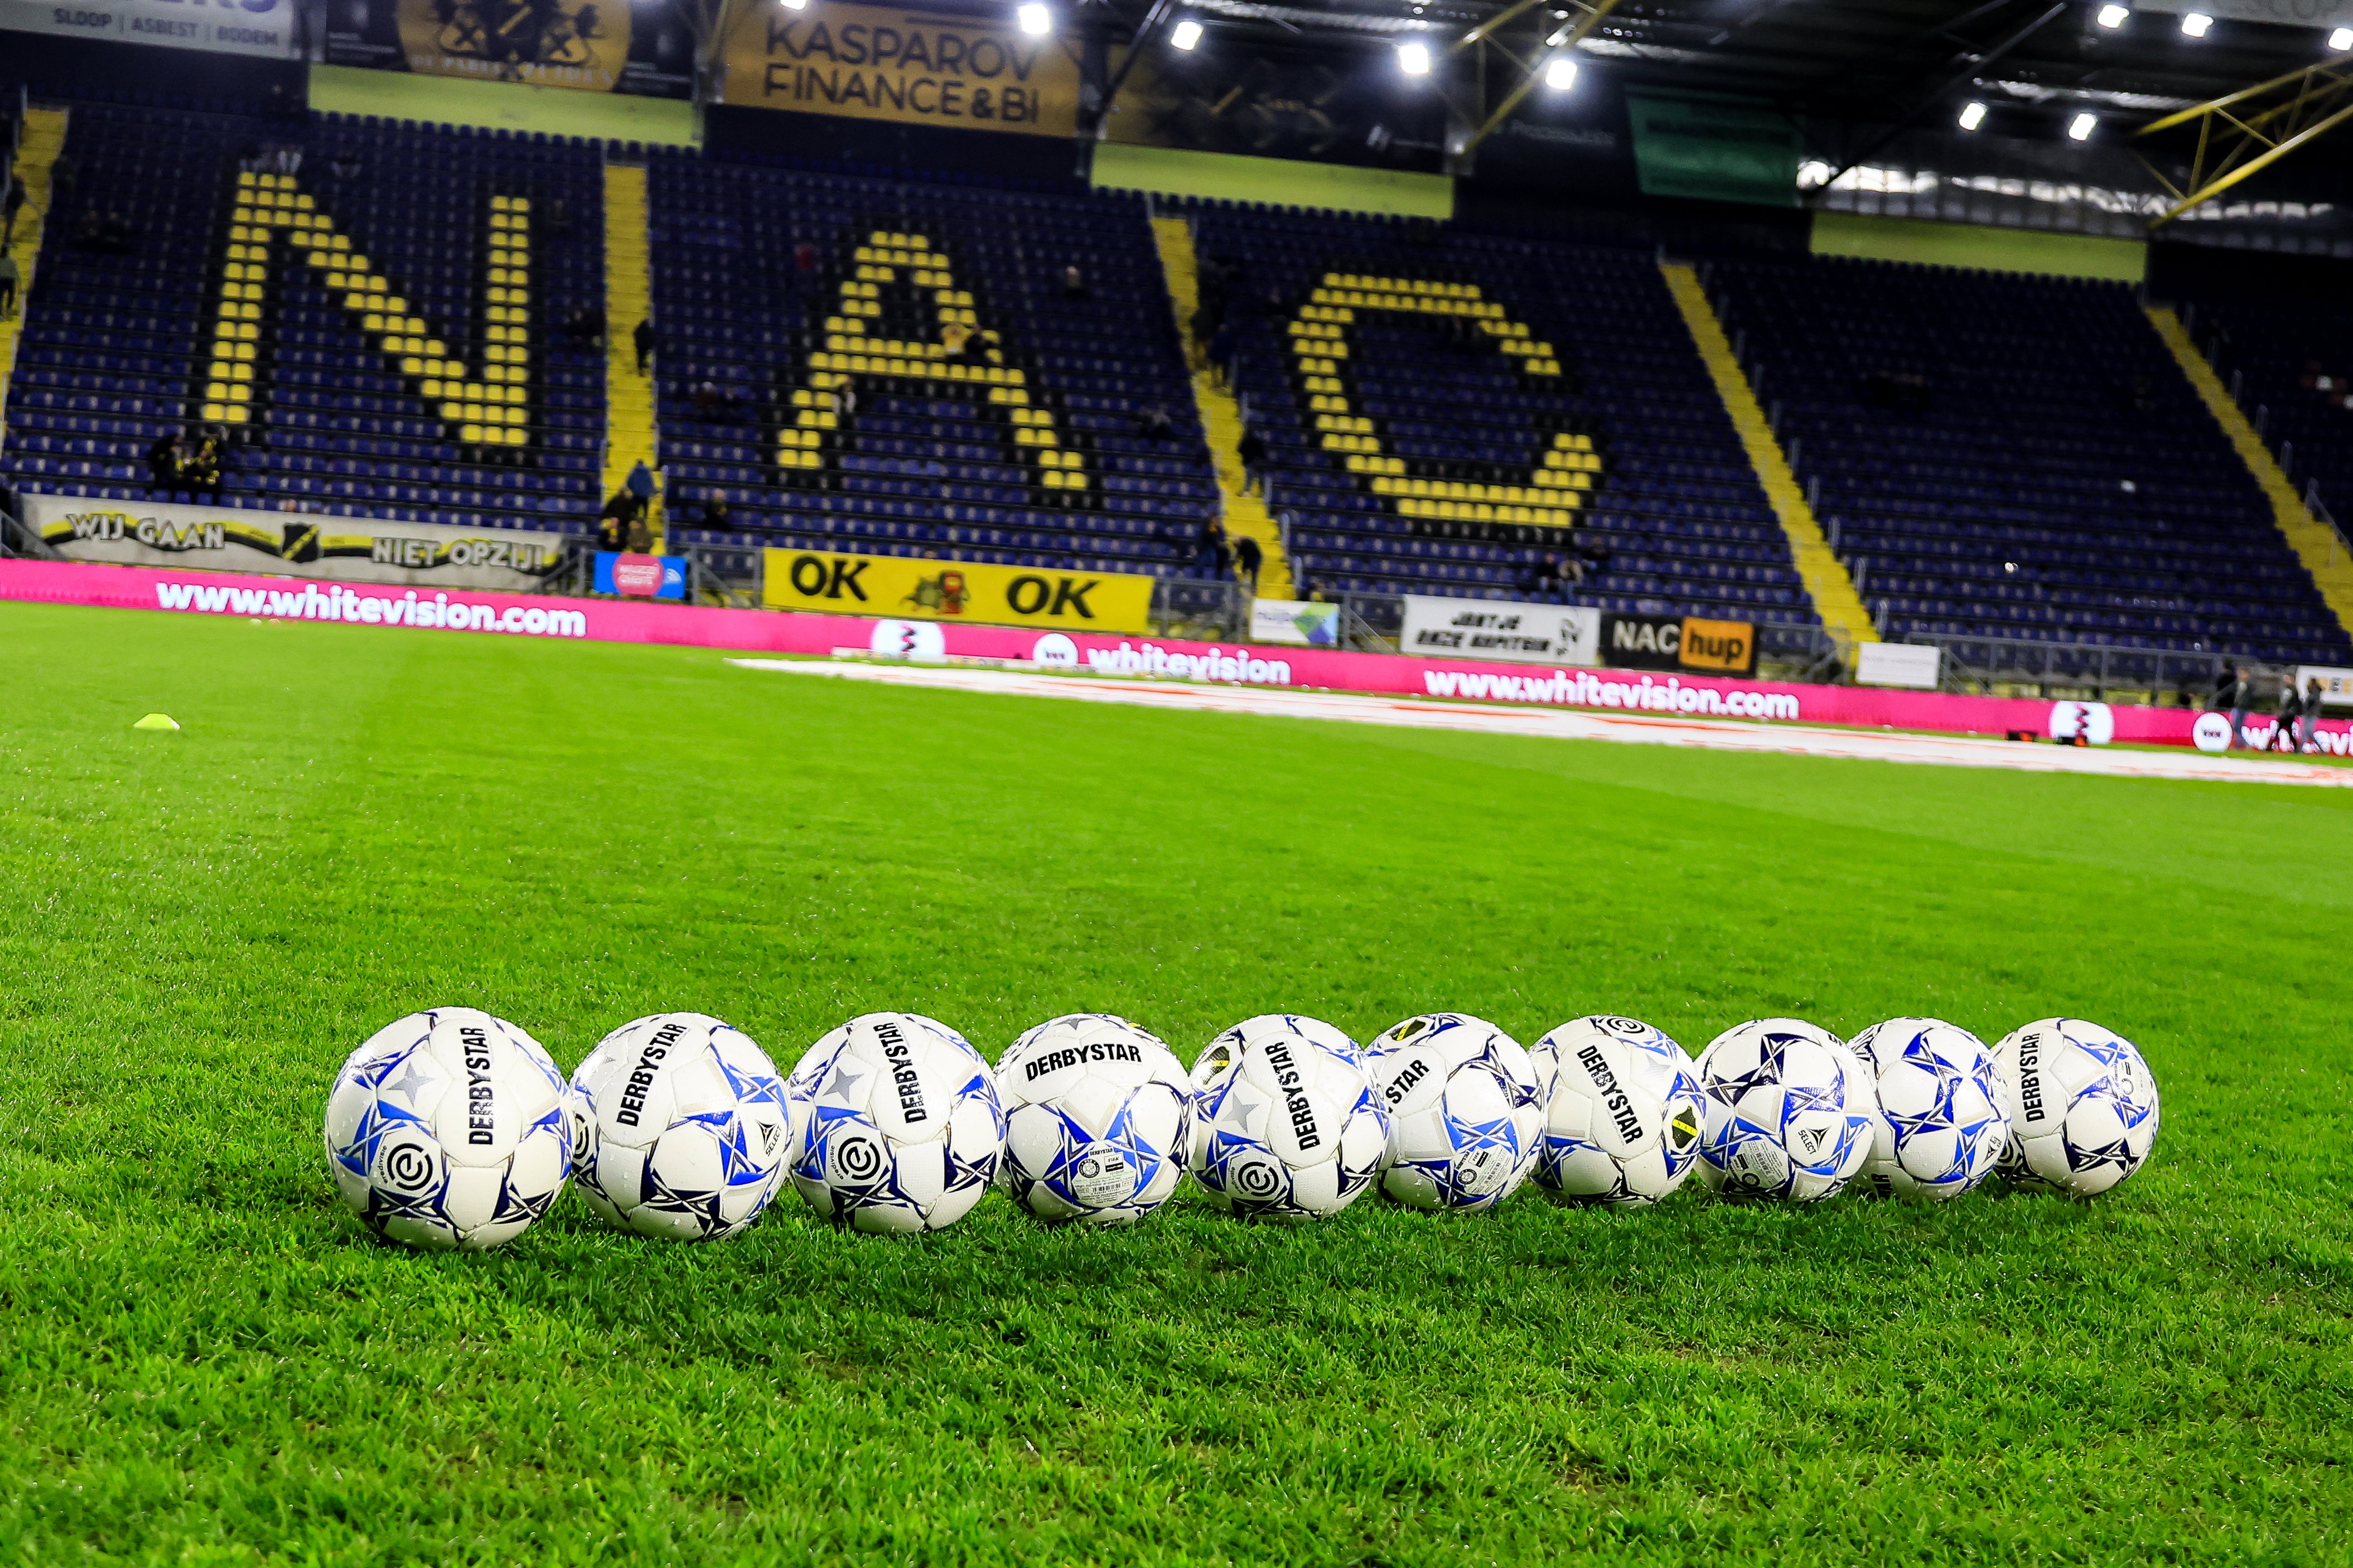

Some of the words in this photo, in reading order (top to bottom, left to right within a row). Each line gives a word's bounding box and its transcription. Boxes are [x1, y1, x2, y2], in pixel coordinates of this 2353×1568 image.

[54, 8, 112, 27] SLOOP
[131, 17, 197, 37] ASBEST
[217, 26, 278, 45] BODEM
[766, 16, 1041, 81] KASPAROV
[66, 513, 126, 540] WIJ
[136, 517, 225, 550] GAAN
[372, 537, 442, 568] NIET
[449, 540, 545, 570] OPZIJ!
[156, 582, 587, 637] www.whitevision.com
[790, 554, 870, 602] OK
[1007, 574, 1099, 619] OK
[1086, 641, 1291, 684] whitevision
[1613, 620, 1680, 655] NAC
[1689, 627, 1745, 665] hup
[1423, 670, 1799, 719] www.whitevision.com
[460, 1027, 493, 1145] DERBYSTAR
[616, 1023, 688, 1127] DERBYSTAR
[873, 1022, 928, 1124] DERBYSTAR
[1026, 1043, 1142, 1082] DERBYSTAR
[2019, 1033, 2046, 1122] DERBYSTAR
[1265, 1041, 1321, 1151] DERBYSTAR
[1577, 1044, 1644, 1145] DERBYSTAR
[378, 1145, 388, 1184] eredivisie
[765, 1126, 782, 1157] SELECT
[829, 1145, 844, 1180] eredivisie
[1798, 1129, 1816, 1155] SELECT
